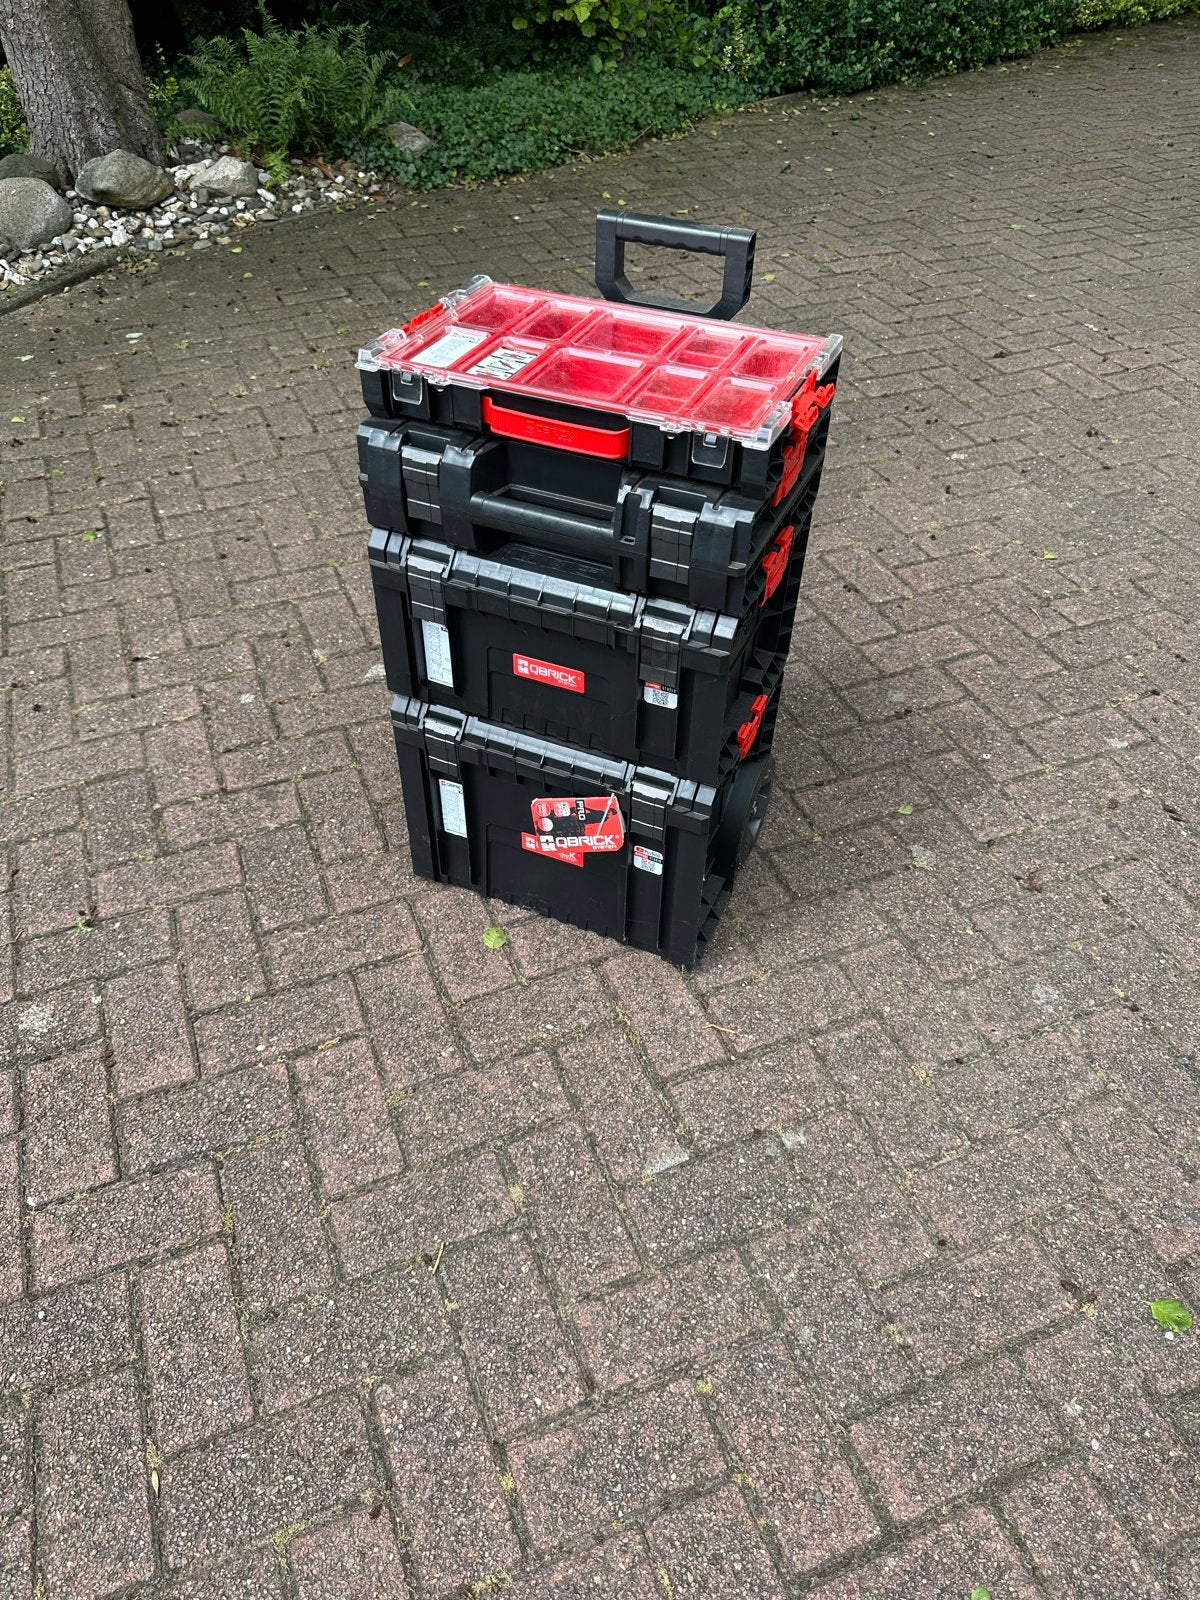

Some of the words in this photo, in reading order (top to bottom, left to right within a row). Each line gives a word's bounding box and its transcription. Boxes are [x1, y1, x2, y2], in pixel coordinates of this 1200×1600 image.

[529, 664, 577, 684] QBRICK
[576, 800, 586, 821] PRO
[555, 834, 616, 849] QBRICK
